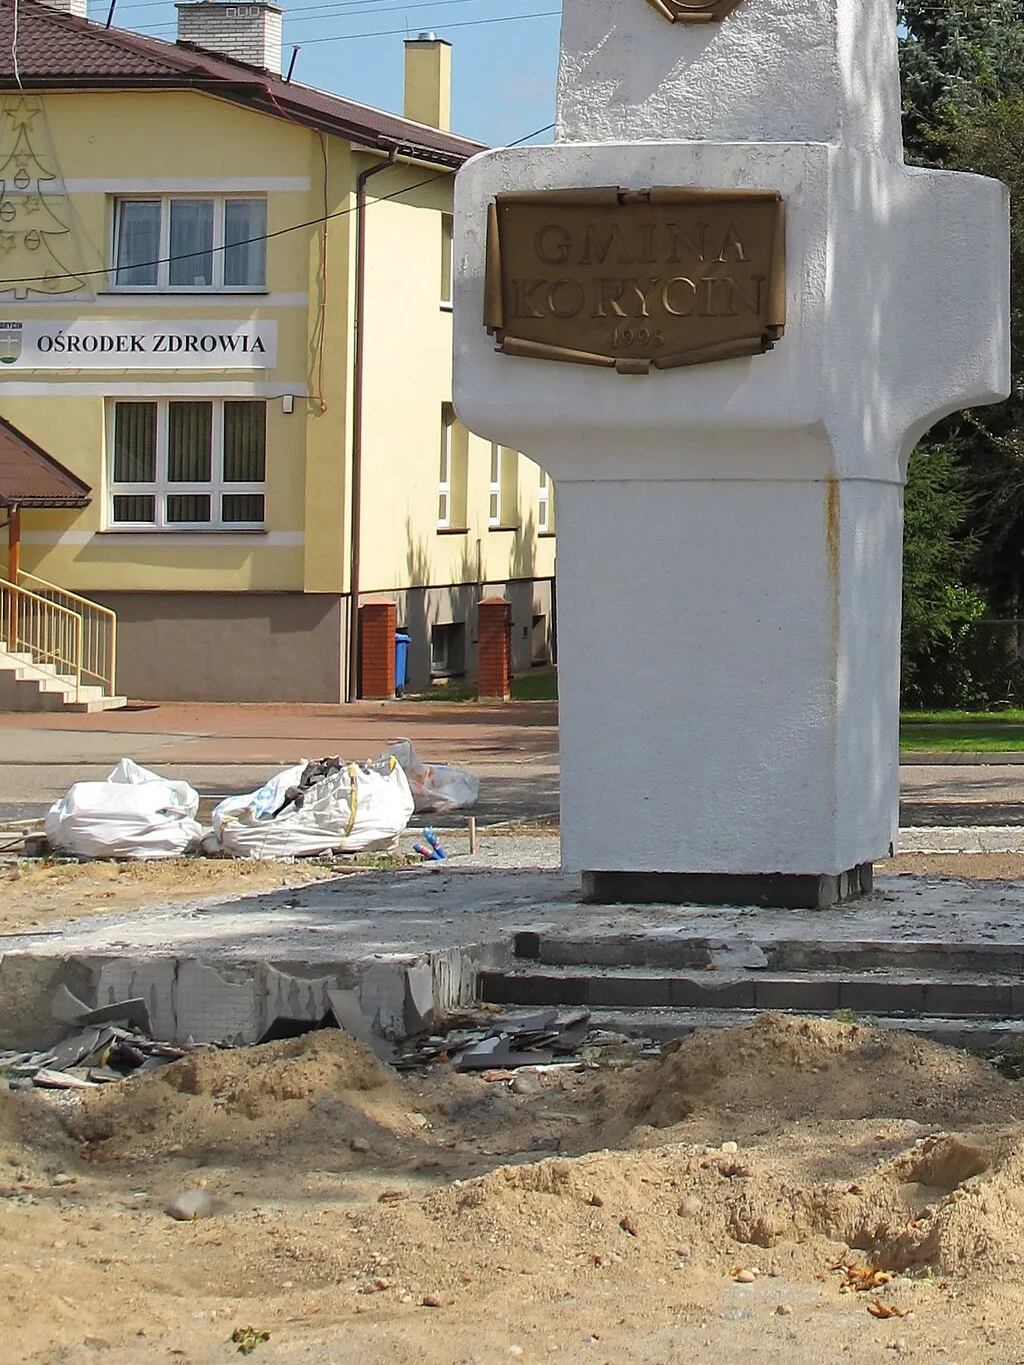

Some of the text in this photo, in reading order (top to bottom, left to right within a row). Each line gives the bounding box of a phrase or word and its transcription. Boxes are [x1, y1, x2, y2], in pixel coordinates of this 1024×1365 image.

[534, 222, 751, 265] GMINA
[510, 275, 766, 318] KORYCIN
[37, 331, 266, 353] OŚRODEK ZDROWIA
[610, 327, 665, 349] 1995
